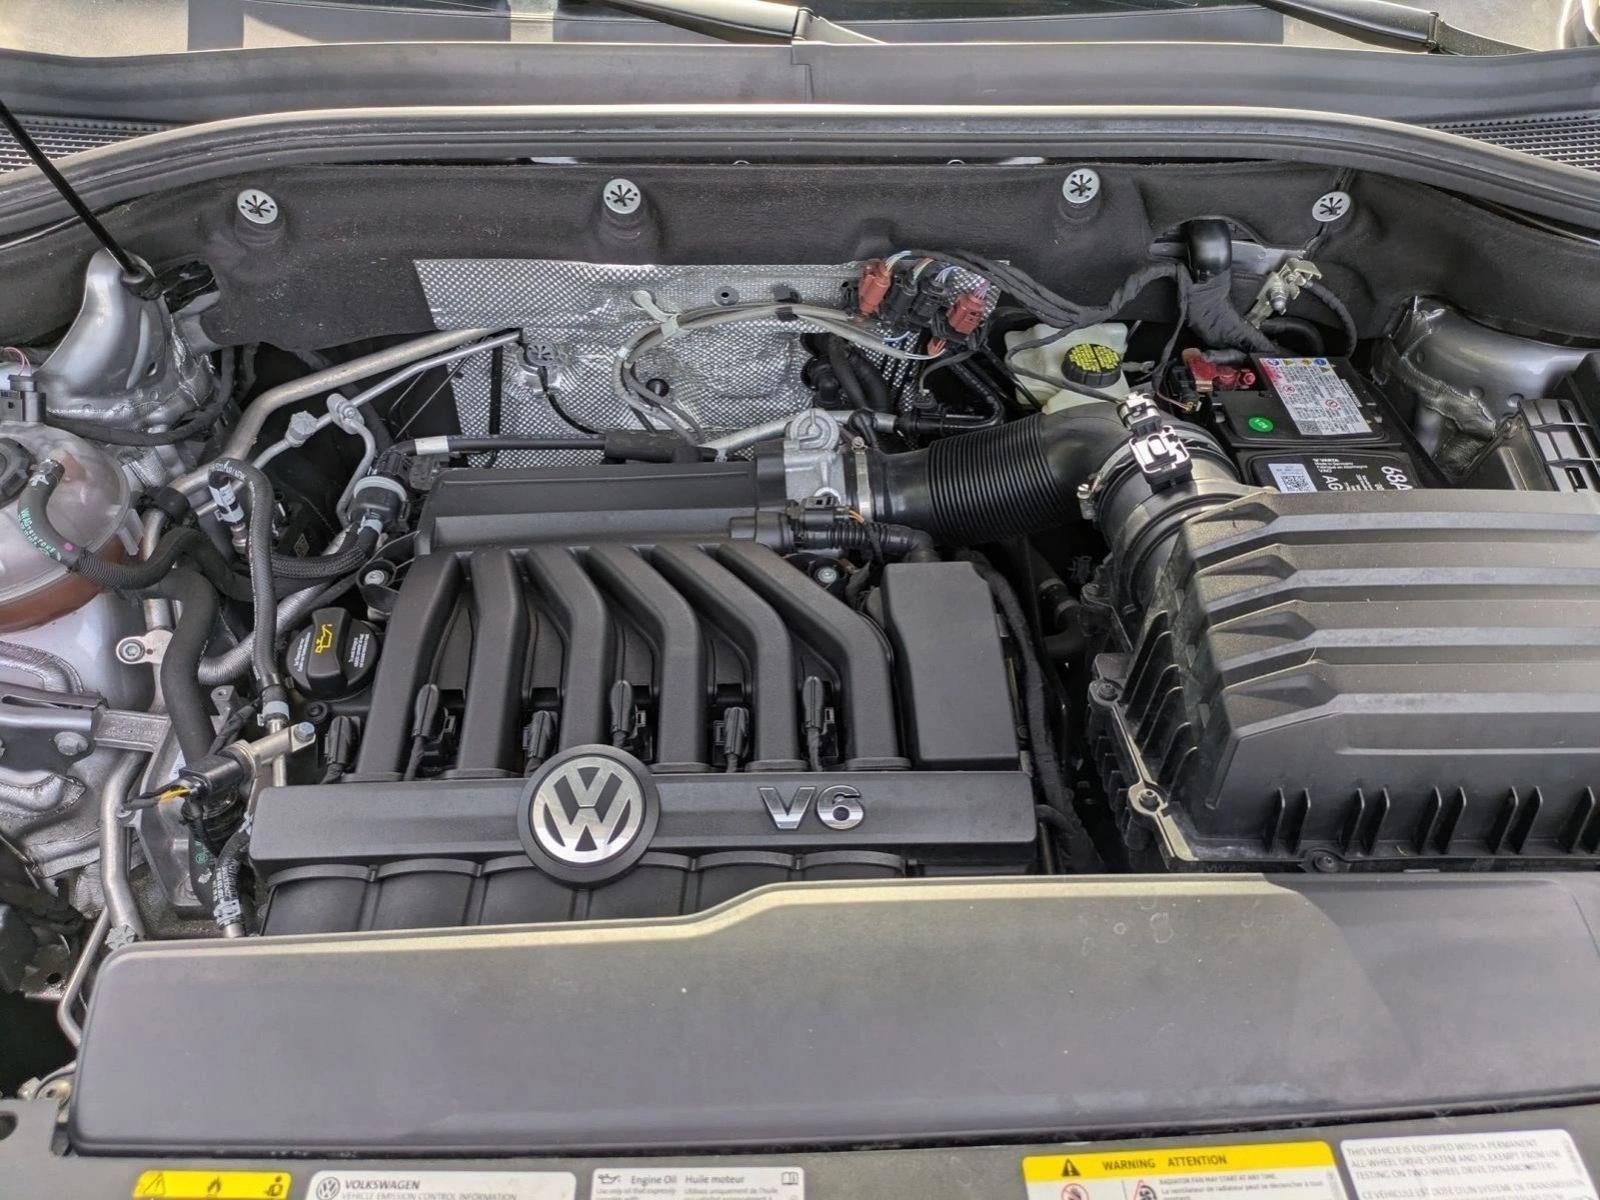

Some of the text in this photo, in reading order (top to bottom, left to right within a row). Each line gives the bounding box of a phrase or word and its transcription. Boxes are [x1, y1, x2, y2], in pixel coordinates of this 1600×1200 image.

[757, 785, 864, 830] V6
[1102, 1154, 1227, 1171] WARNING ATTENTION
[345, 1180, 420, 1190] VOLKSWAGEN
[631, 1175, 745, 1187] Engine Oil Huile moteur
